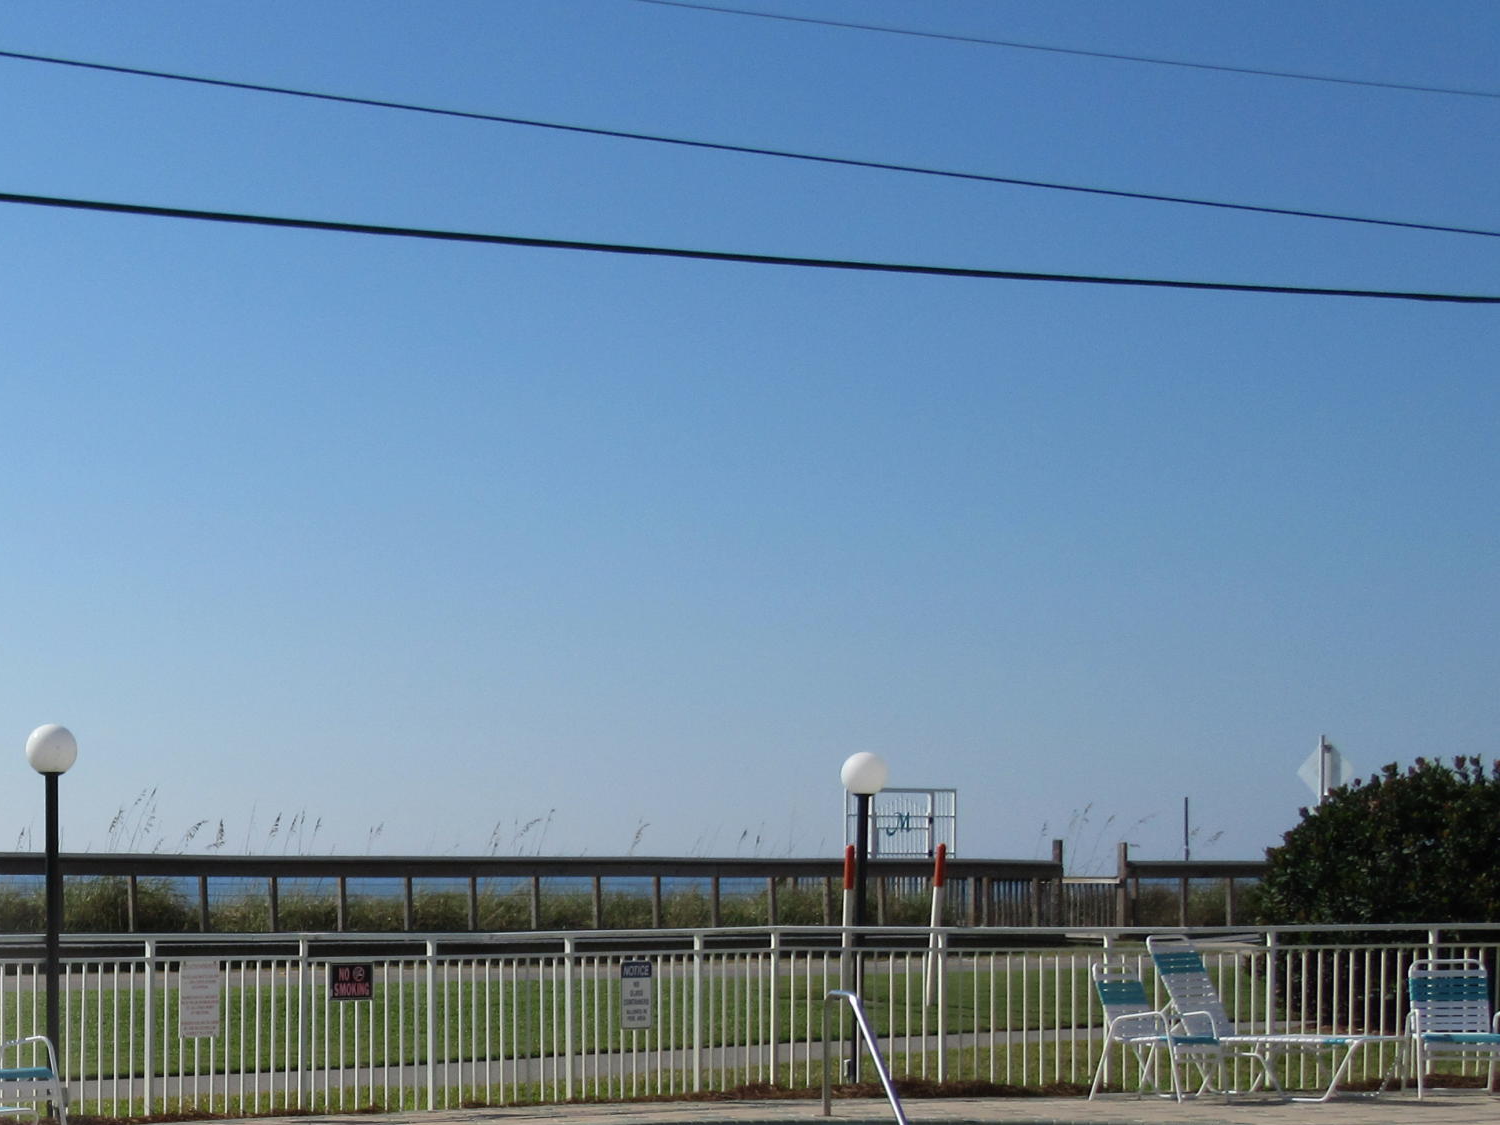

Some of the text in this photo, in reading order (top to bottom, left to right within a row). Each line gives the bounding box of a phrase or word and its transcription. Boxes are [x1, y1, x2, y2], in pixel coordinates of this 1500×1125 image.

[338, 967, 350, 981] NO
[623, 965, 649, 976] NOTICE
[334, 982, 370, 997] SMOKING
